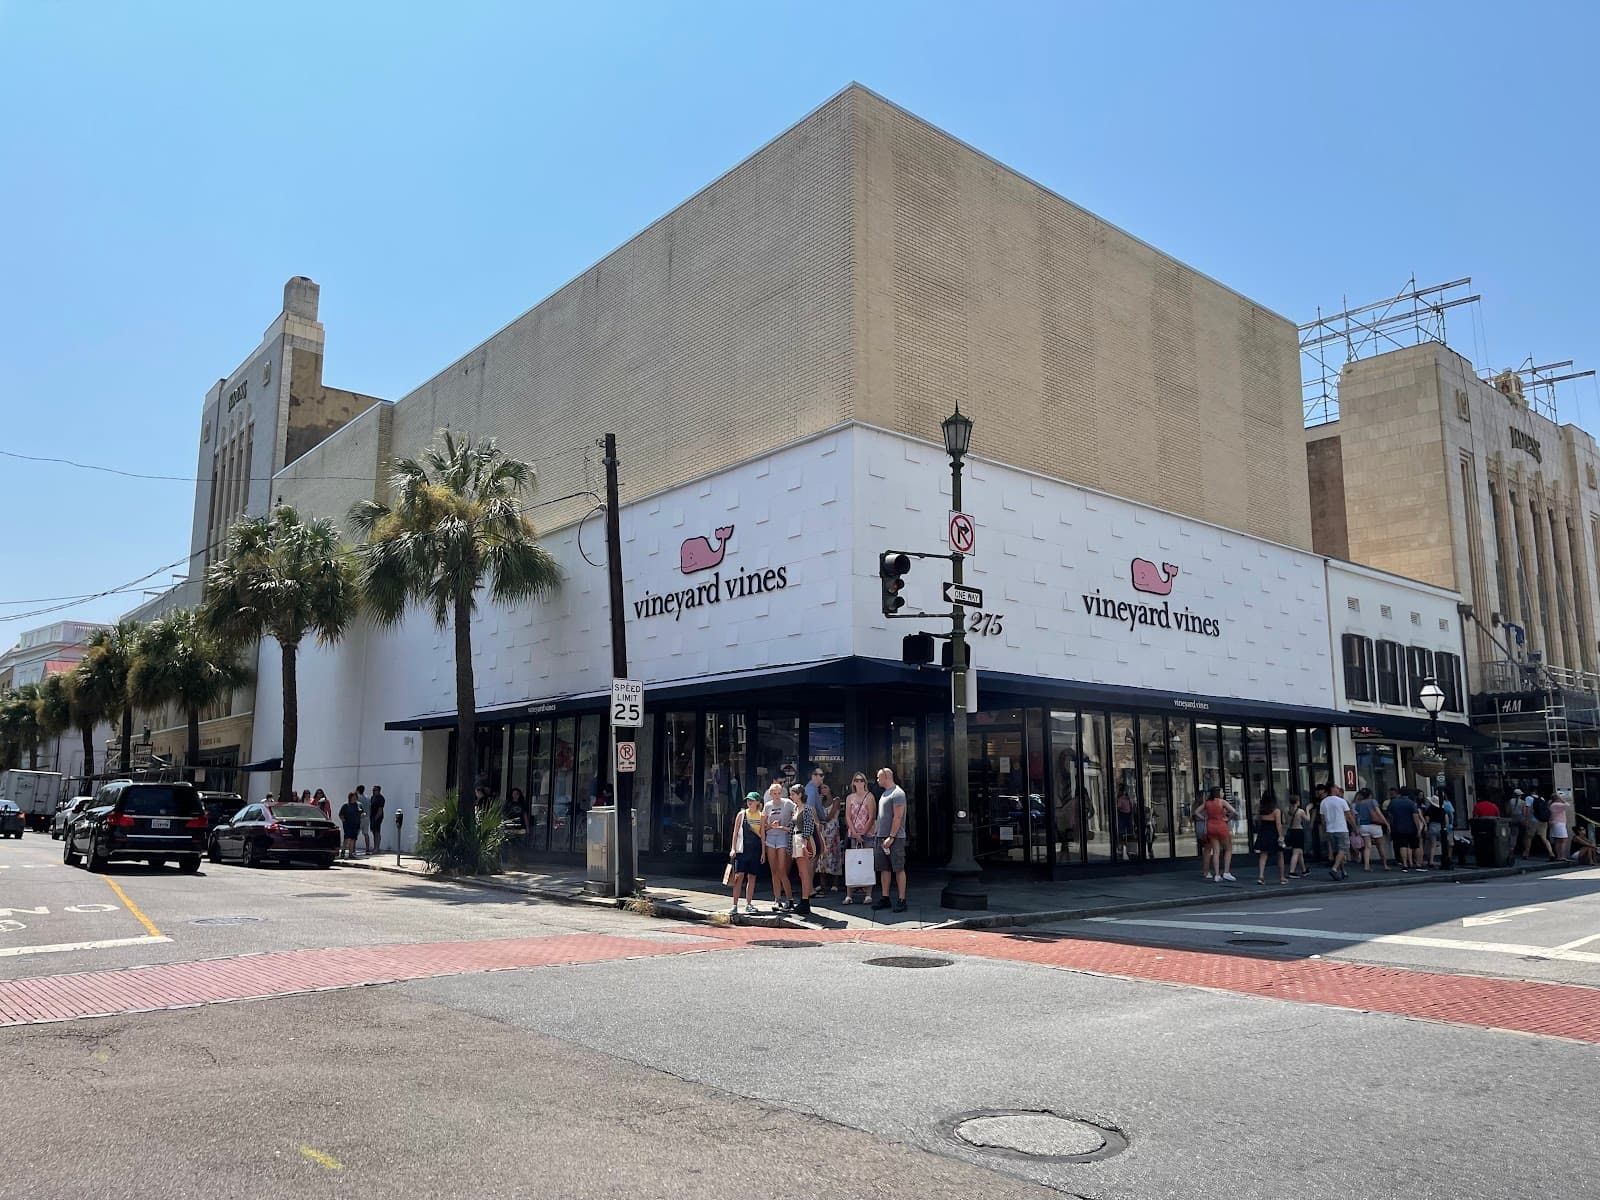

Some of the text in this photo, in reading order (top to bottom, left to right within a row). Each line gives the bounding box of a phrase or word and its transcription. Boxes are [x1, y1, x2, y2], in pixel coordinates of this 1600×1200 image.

[633, 566, 787, 621] vineyard vines
[955, 591, 979, 602] ONE WAY
[1082, 589, 1220, 637] vineyard vines
[969, 612, 1004, 637] 275
[614, 684, 641, 693] SPEED
[617, 694, 638, 702] LIMIT
[614, 703, 640, 720] 25
